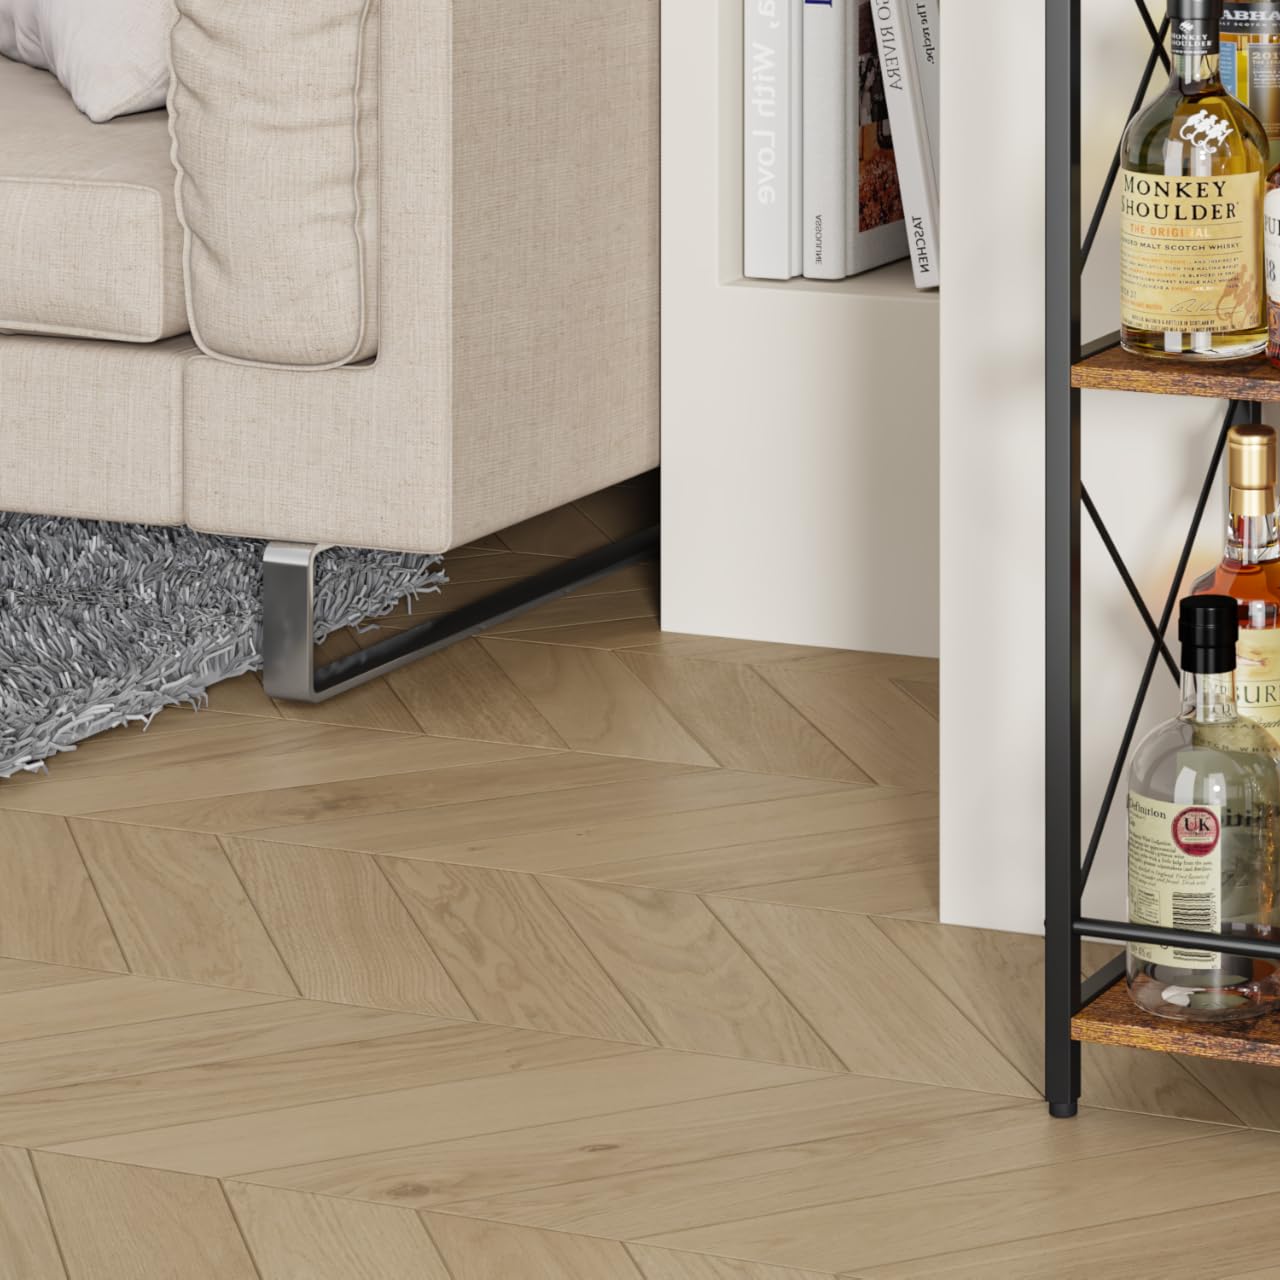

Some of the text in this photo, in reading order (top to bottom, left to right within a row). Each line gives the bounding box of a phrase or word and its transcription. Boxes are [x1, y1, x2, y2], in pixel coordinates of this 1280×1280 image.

[1123, 173, 1227, 199] MONKEY
[1121, 194, 1237, 221] SHOULDER
[1129, 223, 1212, 239] THE ORIGIAL
[1140, 241, 1161, 250] MALT
[1208, 242, 1240, 252] WHISKY
[1183, 817, 1211, 832] UK
